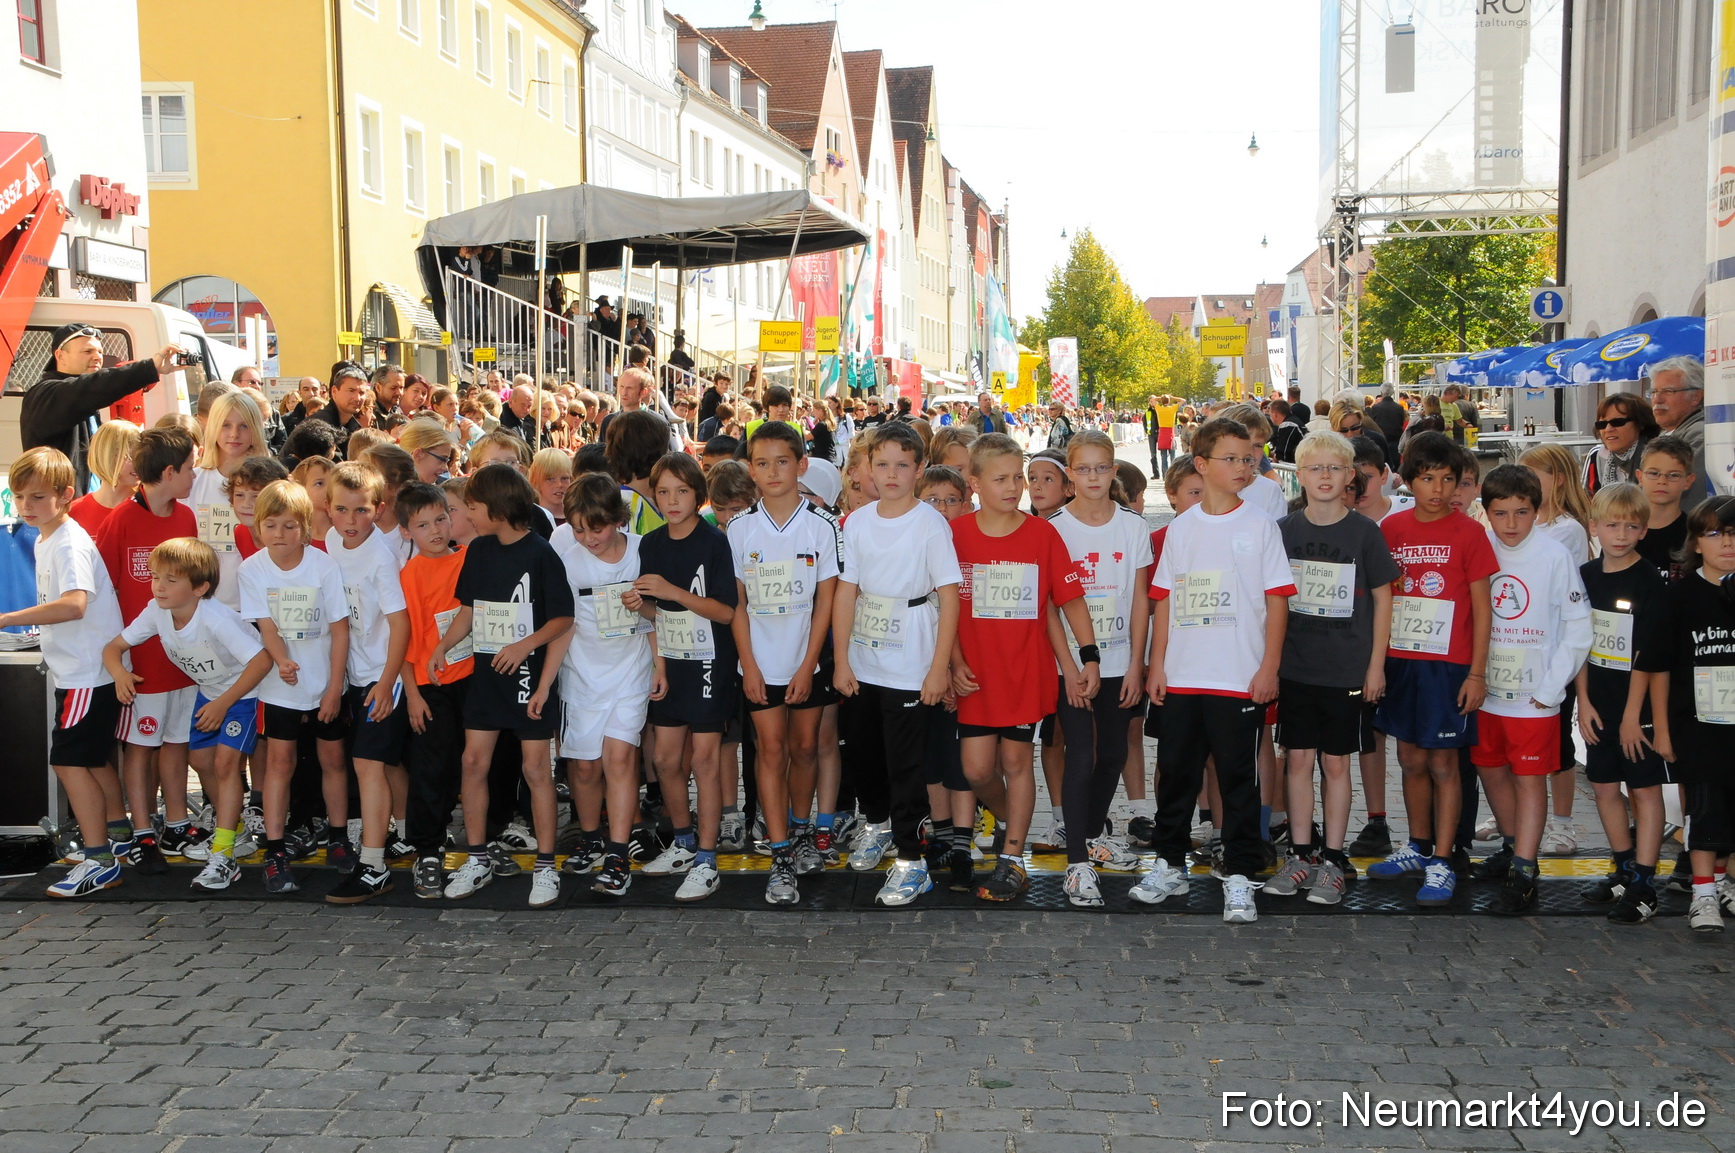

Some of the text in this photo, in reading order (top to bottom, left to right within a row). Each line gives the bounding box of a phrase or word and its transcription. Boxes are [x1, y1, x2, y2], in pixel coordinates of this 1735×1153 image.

[797, 260, 829, 273] NEU
[799, 273, 830, 283] MARKT
[762, 328, 800, 338] Schnupper-
[815, 326, 839, 336] Jugend-
[774, 337, 787, 346] lauf
[821, 333, 833, 342] lauf
[1203, 334, 1244, 343] Schnupper-
[1216, 342, 1230, 350] lauf
[994, 379, 1003, 390] A
[1256, 386, 1262, 394] B
[212, 507, 230, 518] Nina
[213, 522, 240, 536] 71
[1403, 546, 1450, 558] TRAUM
[759, 565, 785, 578] Daniel
[989, 569, 1013, 580] Henri
[1305, 565, 1333, 578] Adrian
[1188, 576, 1211, 587] Anton
[762, 580, 804, 597] 7243
[990, 586, 1032, 601] 7092
[1306, 582, 1348, 599] 7246
[281, 590, 308, 602] Julian
[1189, 592, 1231, 608] 7252
[486, 606, 510, 617] Josua
[1404, 600, 1422, 612] Paul
[282, 607, 320, 623] 7260
[664, 614, 687, 625] Aaron
[488, 622, 528, 638] 7119
[864, 614, 901, 634] 7235
[1403, 617, 1446, 636] 7237
[667, 629, 707, 643] 7118
[1706, 626, 1729, 640] bin
[1593, 631, 1626, 651] 7266
[1490, 650, 1516, 662] Jonas
[179, 660, 215, 675] 7317
[1492, 666, 1534, 683] 7241
[139, 724, 155, 732] FCN
